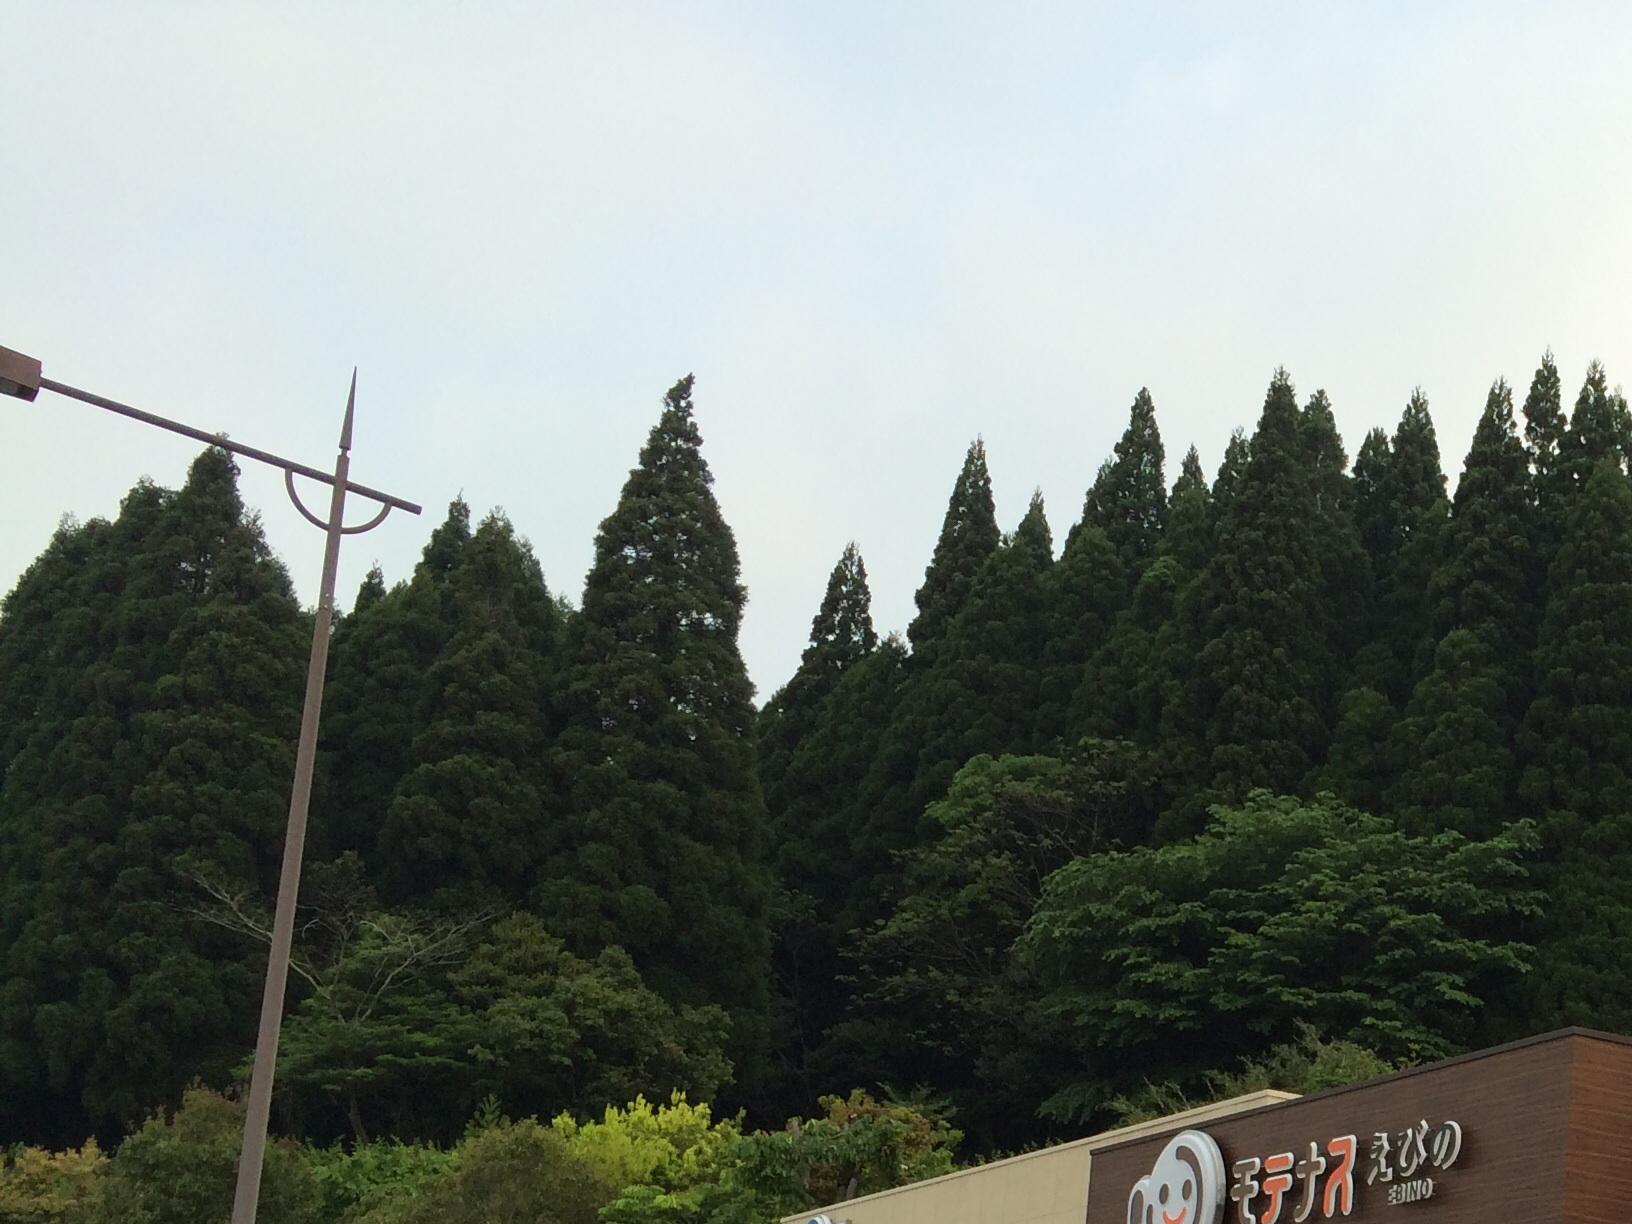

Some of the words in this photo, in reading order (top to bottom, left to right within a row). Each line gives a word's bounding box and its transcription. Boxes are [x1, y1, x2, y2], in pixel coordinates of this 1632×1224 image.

[1368, 1118, 1463, 1186] えびの
[1387, 1177, 1436, 1206] EBINO
